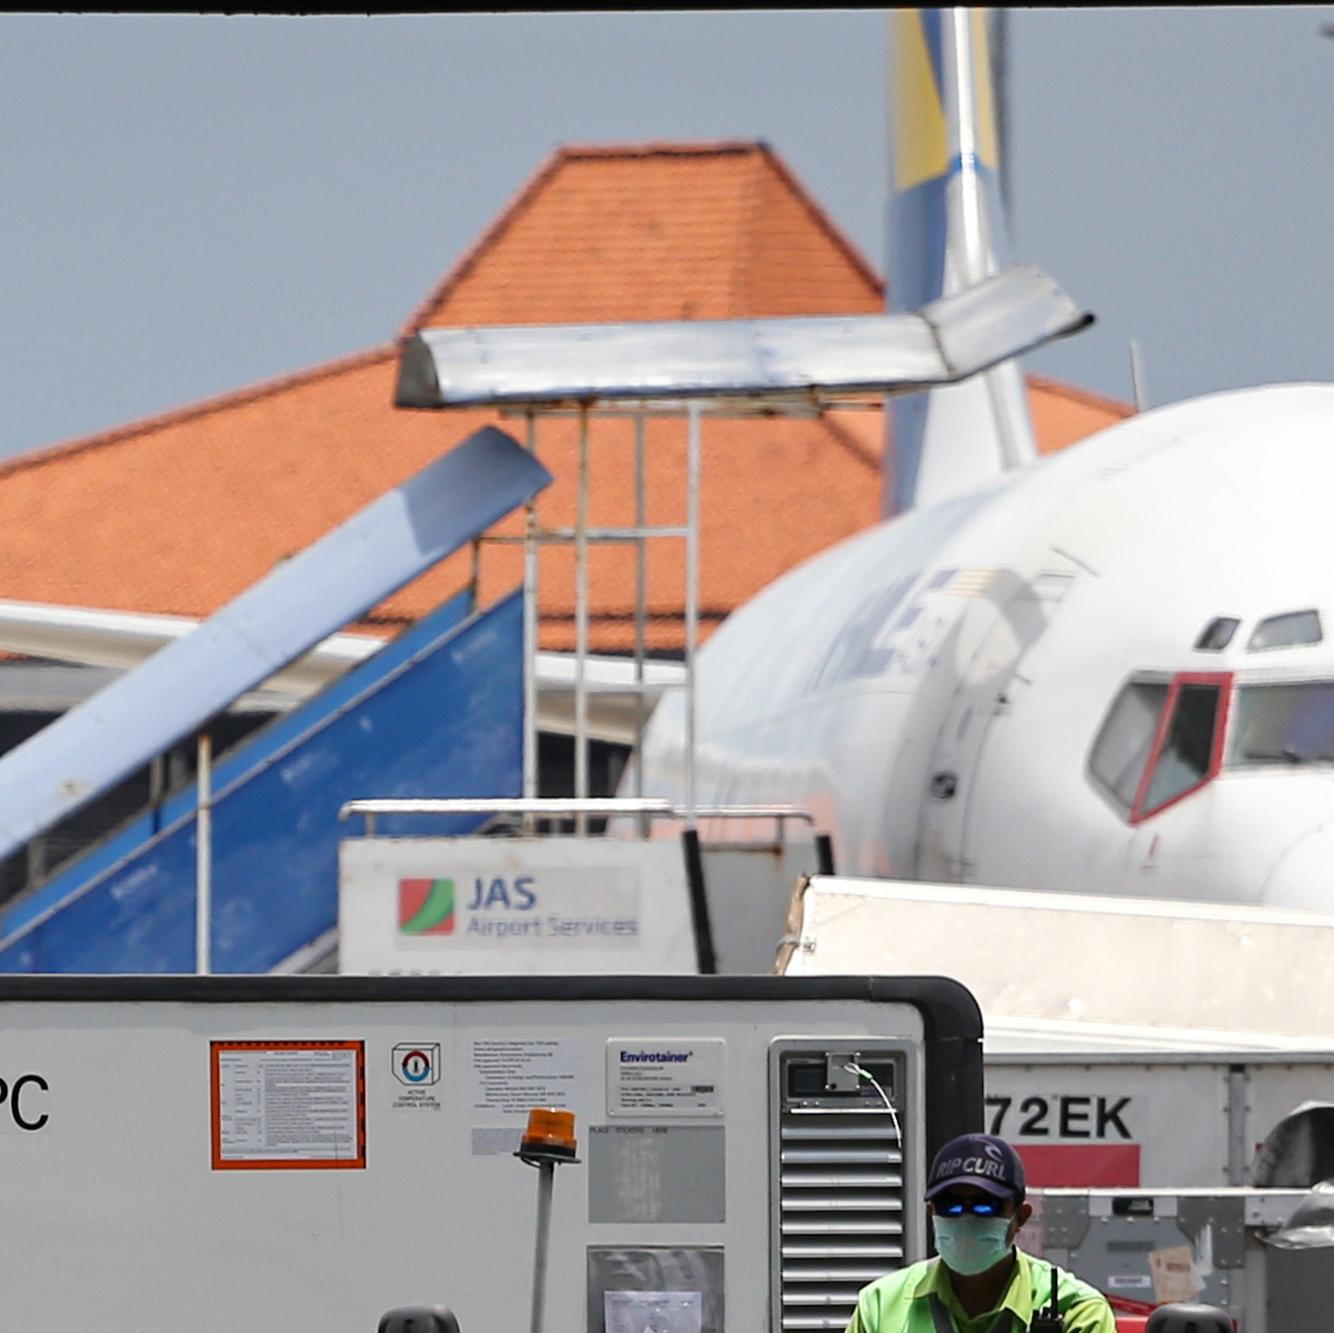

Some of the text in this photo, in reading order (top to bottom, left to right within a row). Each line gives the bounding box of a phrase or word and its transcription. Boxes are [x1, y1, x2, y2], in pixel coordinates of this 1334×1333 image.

[468, 877, 537, 911] JAS
[468, 916, 638, 939] Airport Services
[936, 1157, 1007, 1180] RIP CURL
